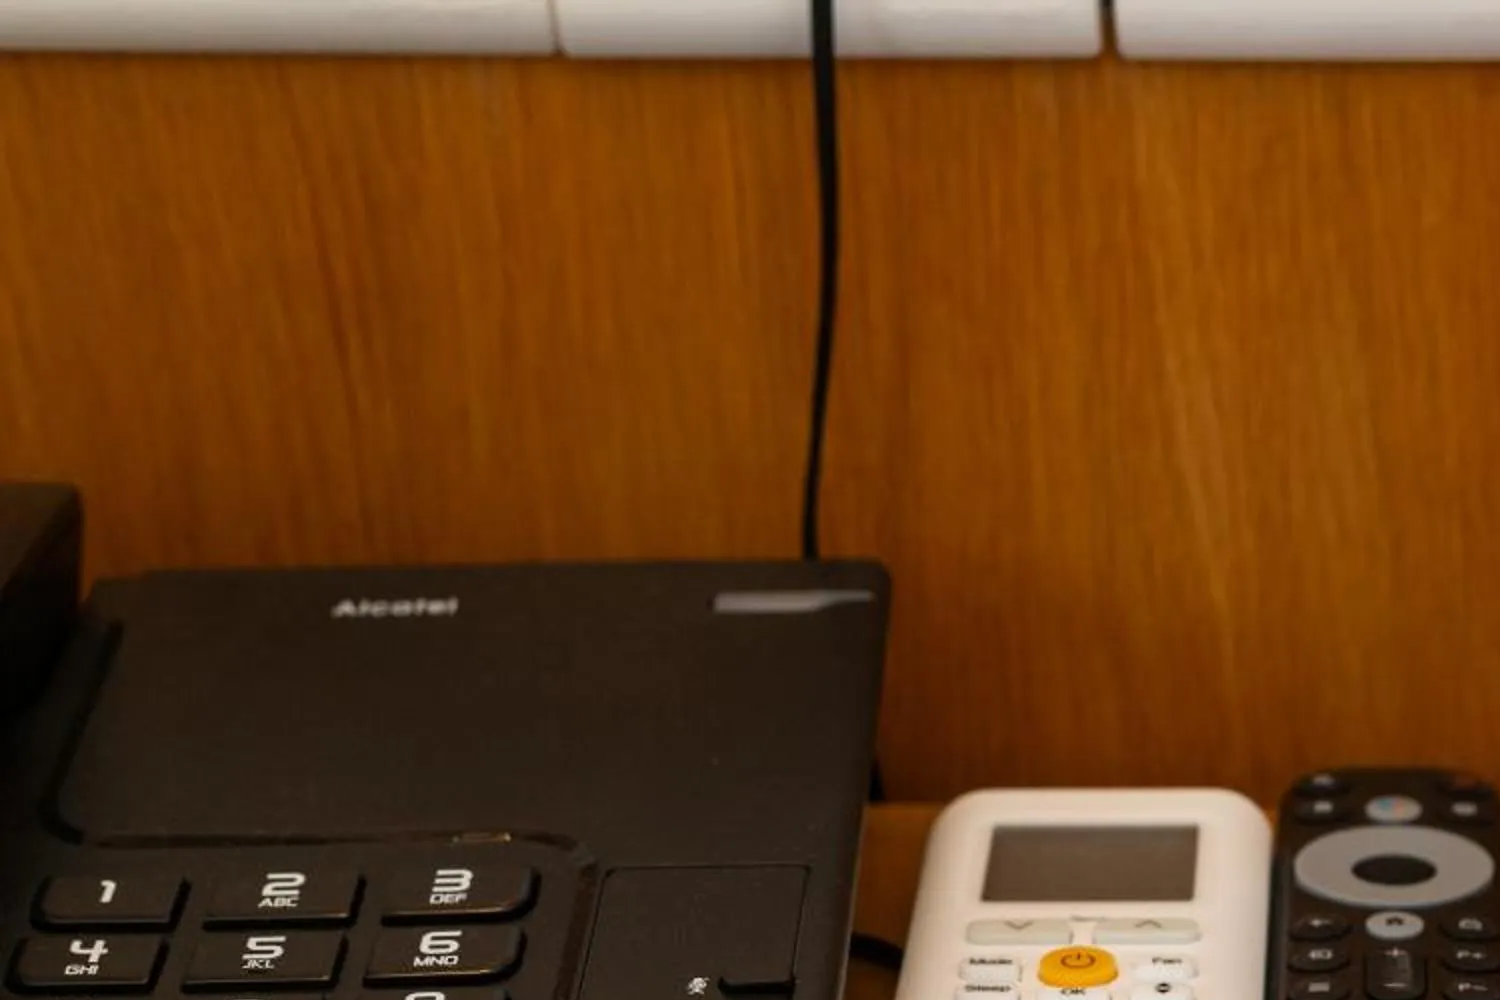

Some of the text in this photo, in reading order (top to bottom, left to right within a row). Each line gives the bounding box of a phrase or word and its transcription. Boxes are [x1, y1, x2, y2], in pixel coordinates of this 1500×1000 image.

[330, 595, 460, 618] Alcatel
[100, 880, 118, 903] 1
[261, 872, 306, 897] 2
[432, 869, 474, 893] 3
[258, 897, 298, 908] ABC
[429, 893, 468, 904] DEF
[69, 939, 109, 963] 4
[242, 936, 287, 960] 5
[419, 930, 463, 955] 6
[64, 963, 100, 975] GHI
[242, 959, 275, 969] JKL
[413, 955, 459, 967] MNO
